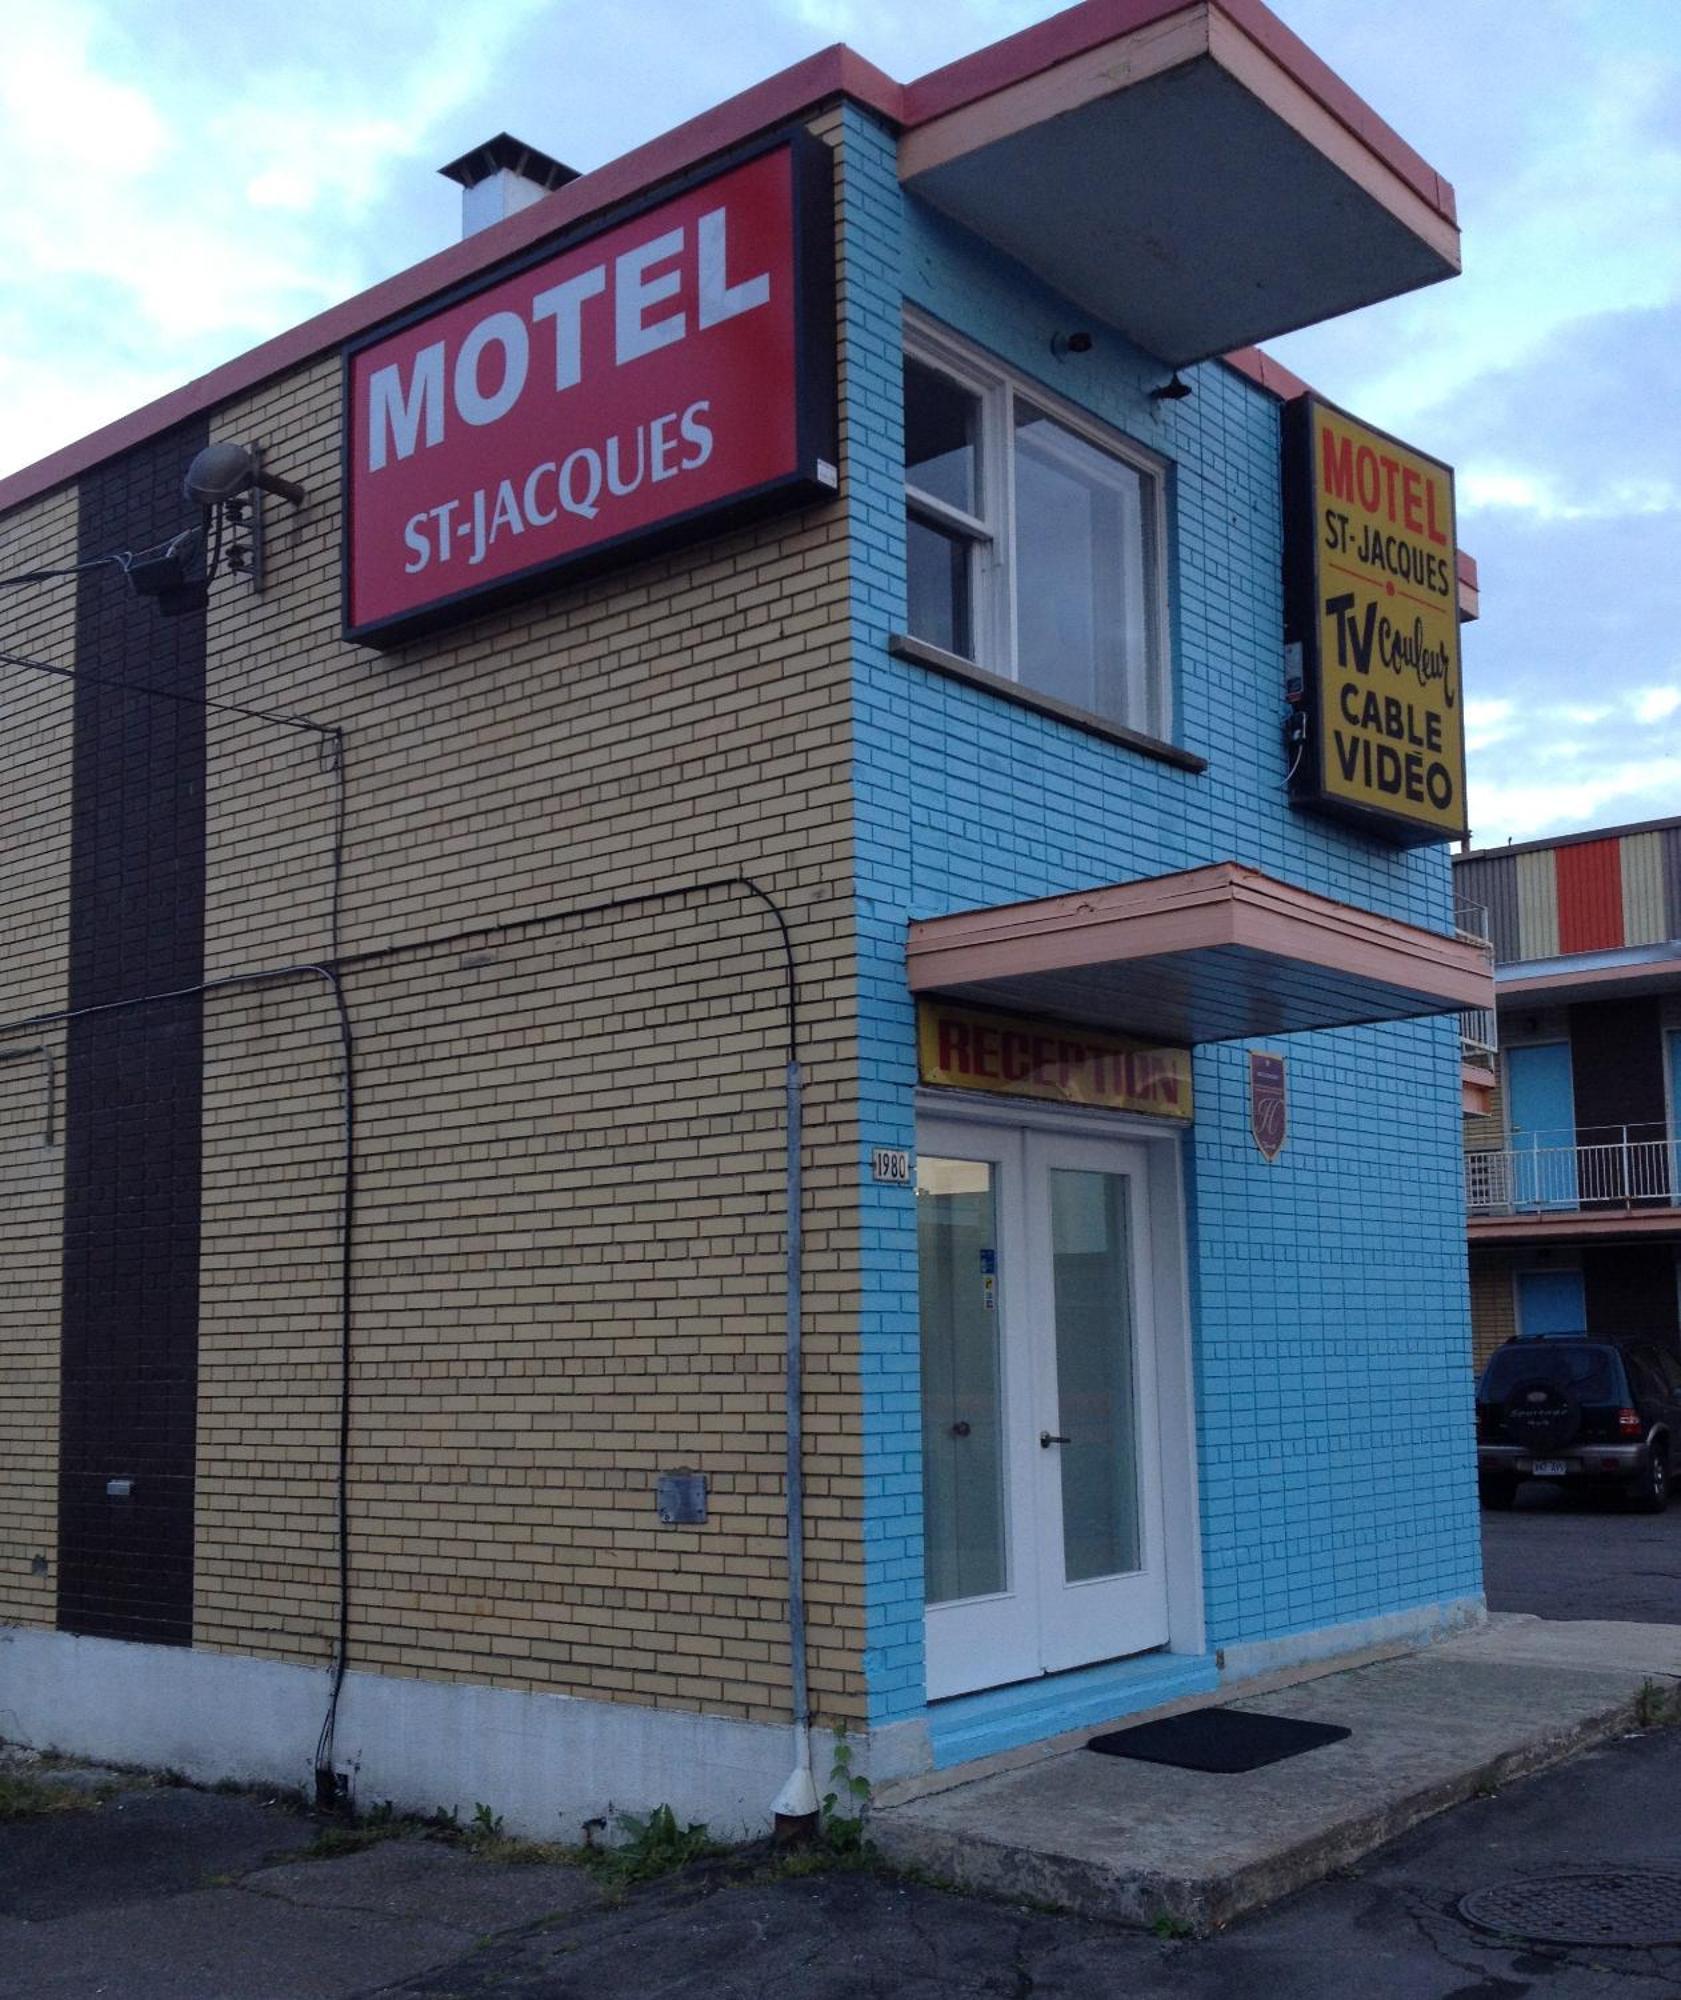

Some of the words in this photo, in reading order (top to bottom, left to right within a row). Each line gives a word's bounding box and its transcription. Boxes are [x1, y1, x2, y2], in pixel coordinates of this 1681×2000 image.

[369, 206, 770, 473] MOTEL
[404, 401, 713, 574] ST-JACQUES
[1322, 426, 1448, 546] MOTEL
[1325, 509, 1449, 597] ST-JACQUES
[1325, 592, 1378, 675] TV
[1340, 682, 1442, 754] CABLE
[938, 1018, 1179, 1105] RECEPTION
[876, 1153, 907, 1180] 1980
